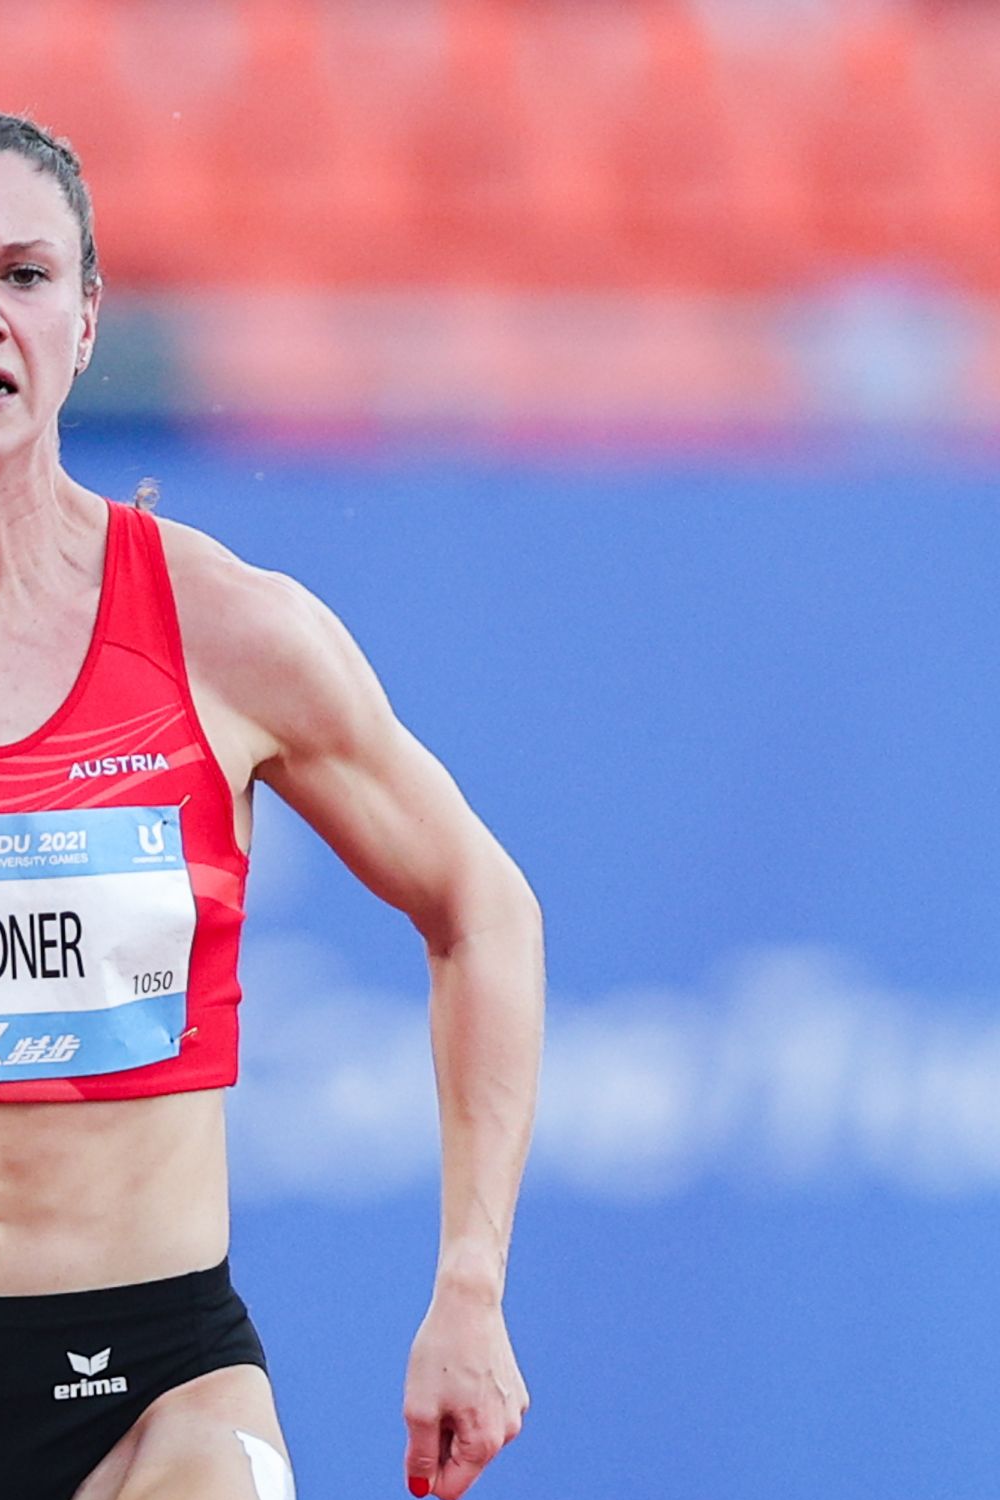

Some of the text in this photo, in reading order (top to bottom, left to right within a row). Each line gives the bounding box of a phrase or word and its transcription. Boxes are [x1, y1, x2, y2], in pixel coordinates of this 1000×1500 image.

[68, 752, 170, 780] AUSTRIA
[38, 830, 87, 853] 2021
[48, 852, 88, 865] GAMES
[132, 970, 174, 995] 1050
[53, 1376, 128, 1400] erima
